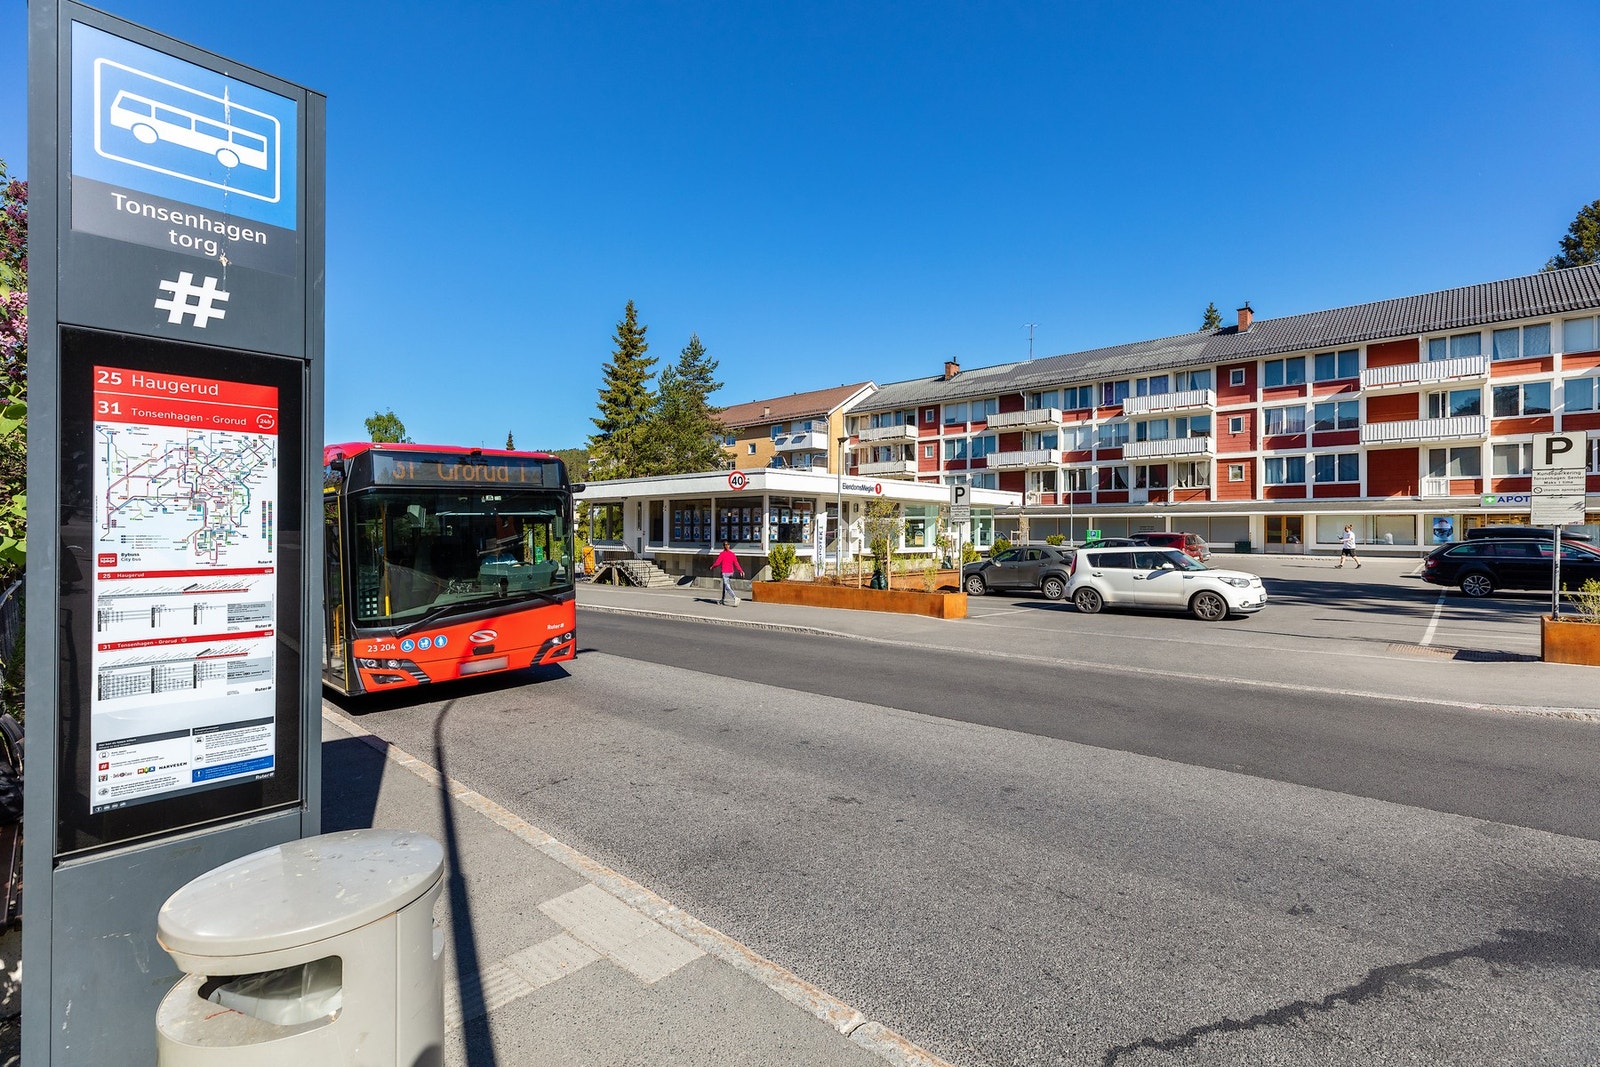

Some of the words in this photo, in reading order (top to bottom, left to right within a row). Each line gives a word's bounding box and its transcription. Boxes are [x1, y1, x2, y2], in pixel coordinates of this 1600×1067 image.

[111, 192, 267, 245] Tonsenhagen
[168, 229, 218, 256] torg
[97, 370, 122, 385] 25
[131, 374, 219, 396] Haugerud
[97, 401, 122, 415] 31
[131, 408, 203, 423] Tonsenhagen
[212, 415, 247, 426] Grorud
[259, 417, 272, 425] 24h
[1545, 436, 1573, 465] P
[392, 460, 414, 480] 31
[436, 461, 509, 483] Grorud
[731, 476, 744, 486] 40
[842, 482, 875, 493] EiendomsMegler
[955, 486, 965, 504] P
[367, 644, 378, 653] 23
[380, 643, 396, 652] 204
